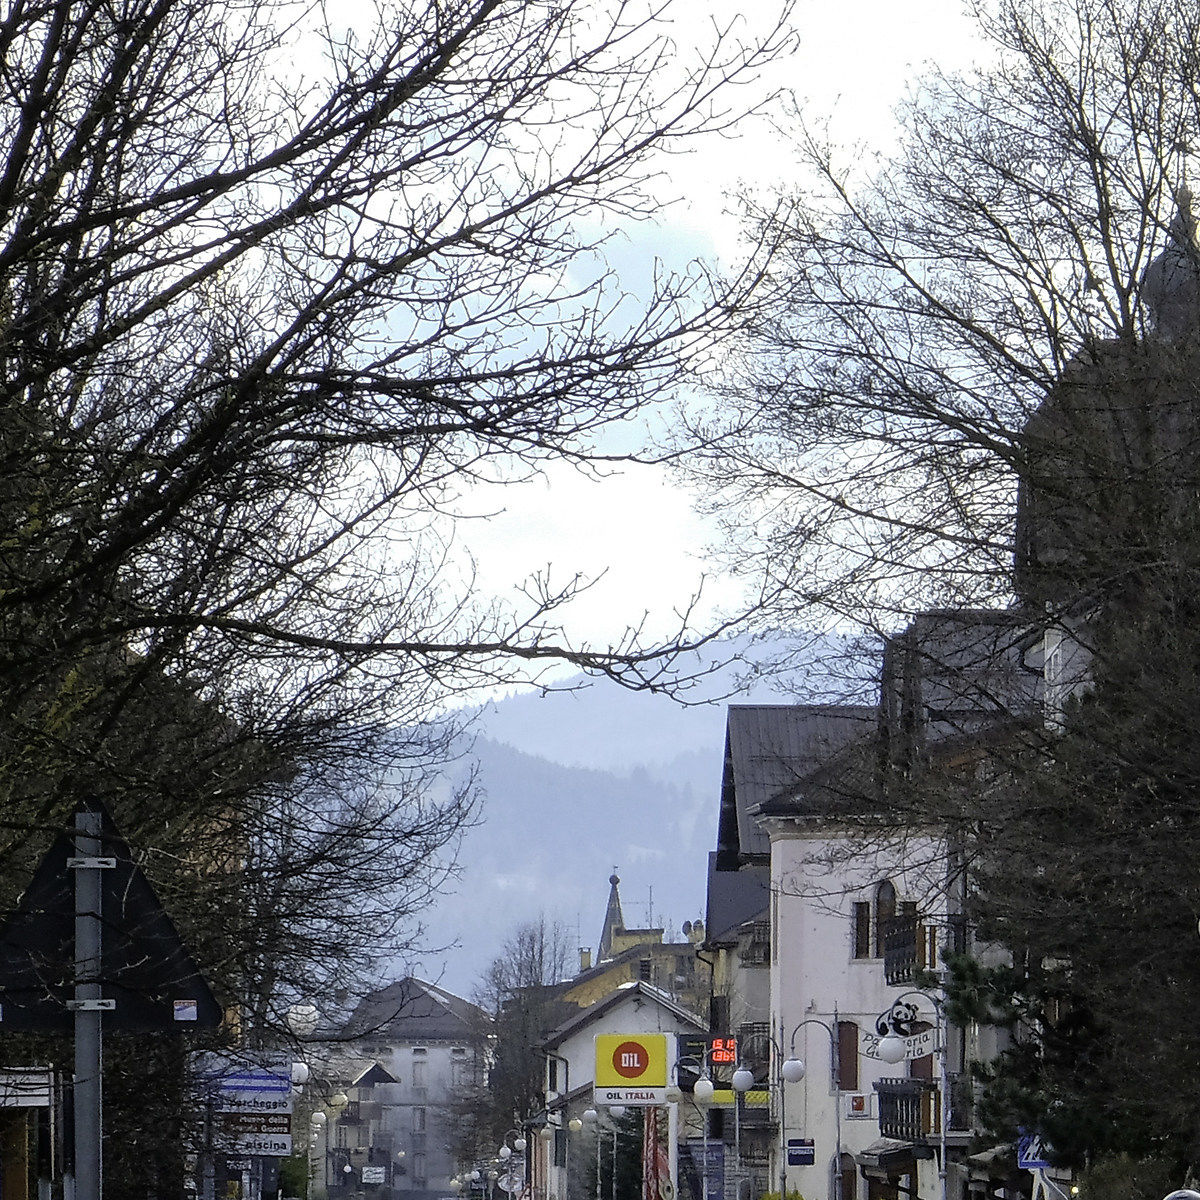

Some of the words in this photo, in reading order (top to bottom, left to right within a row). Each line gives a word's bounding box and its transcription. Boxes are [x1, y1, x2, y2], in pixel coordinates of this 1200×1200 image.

[606, 1092, 622, 1100] OIL
[625, 1092, 655, 1100] ITALIA
[268, 1115, 288, 1124] della
[261, 1124, 288, 1133] Guerra
